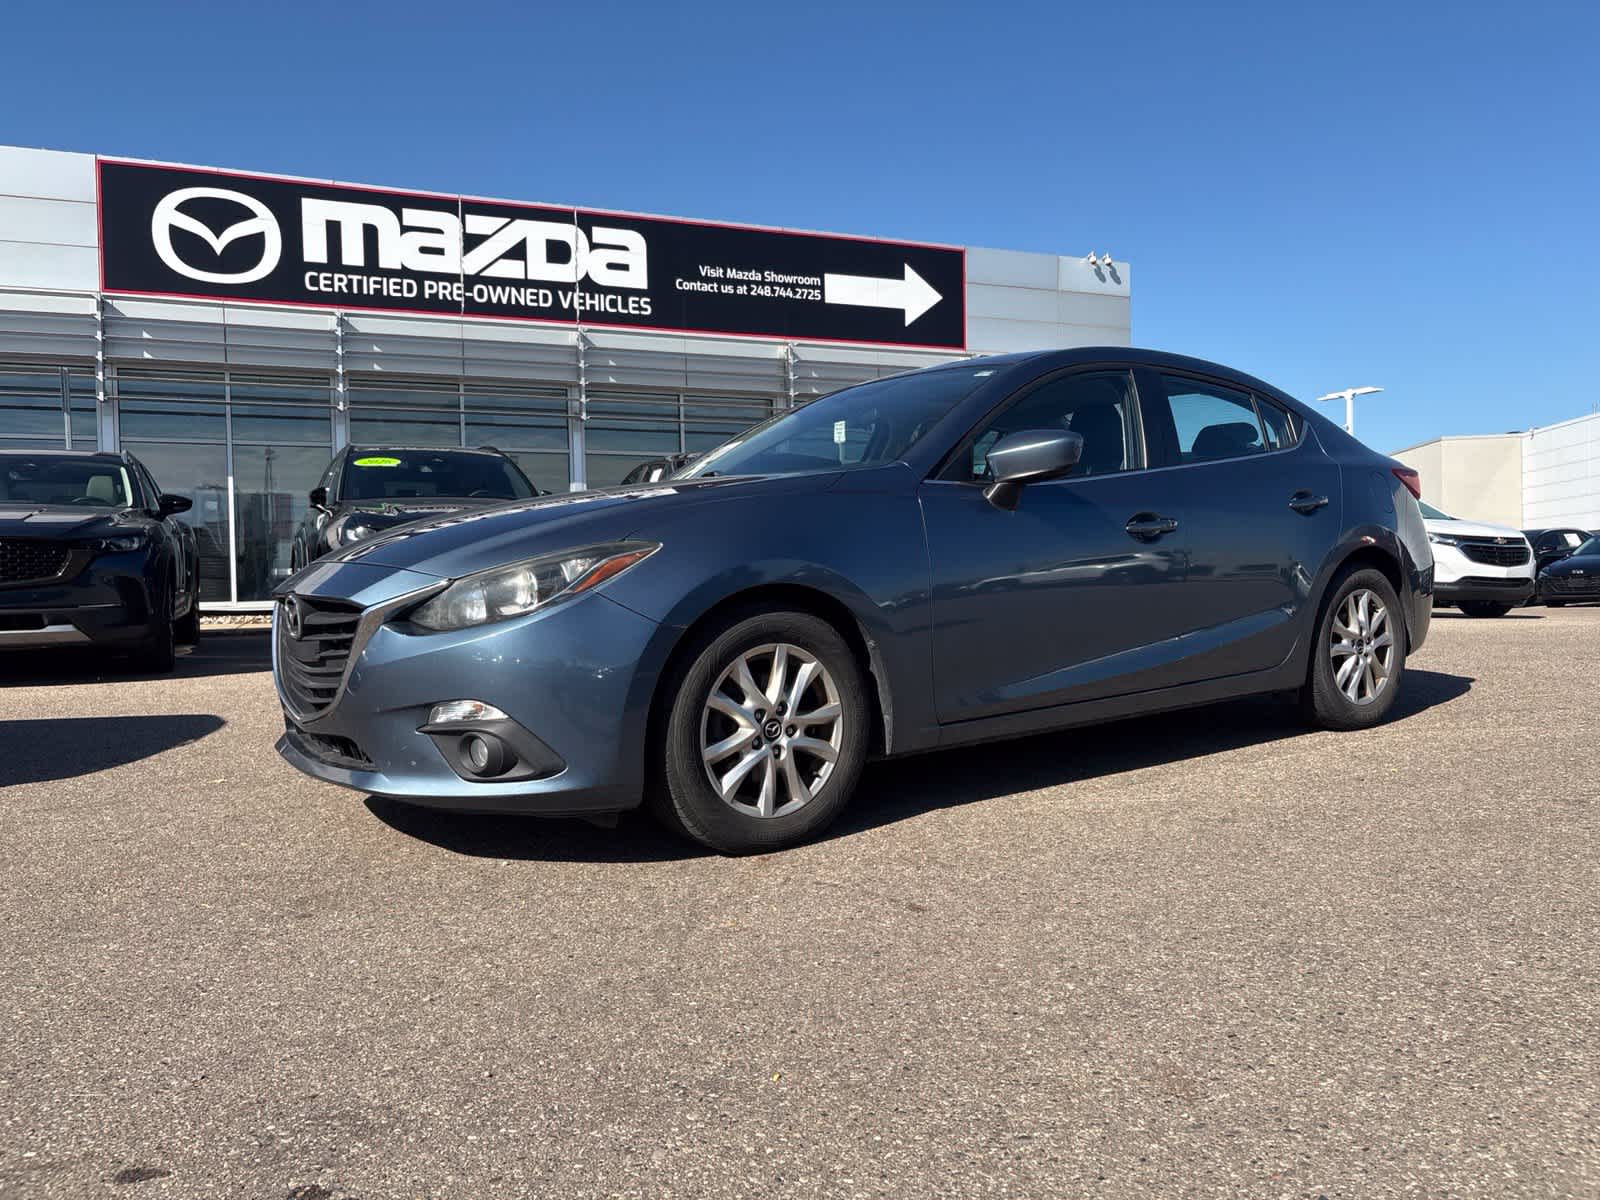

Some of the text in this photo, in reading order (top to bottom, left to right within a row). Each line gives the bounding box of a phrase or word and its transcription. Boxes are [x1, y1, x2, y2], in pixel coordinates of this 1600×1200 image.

[699, 265, 821, 286] Visit Mazda Showroom
[304, 272, 652, 316] CERTIFIED PRE-OWNED VEHICLES
[675, 278, 821, 301] Contact us at 248.744.2725
